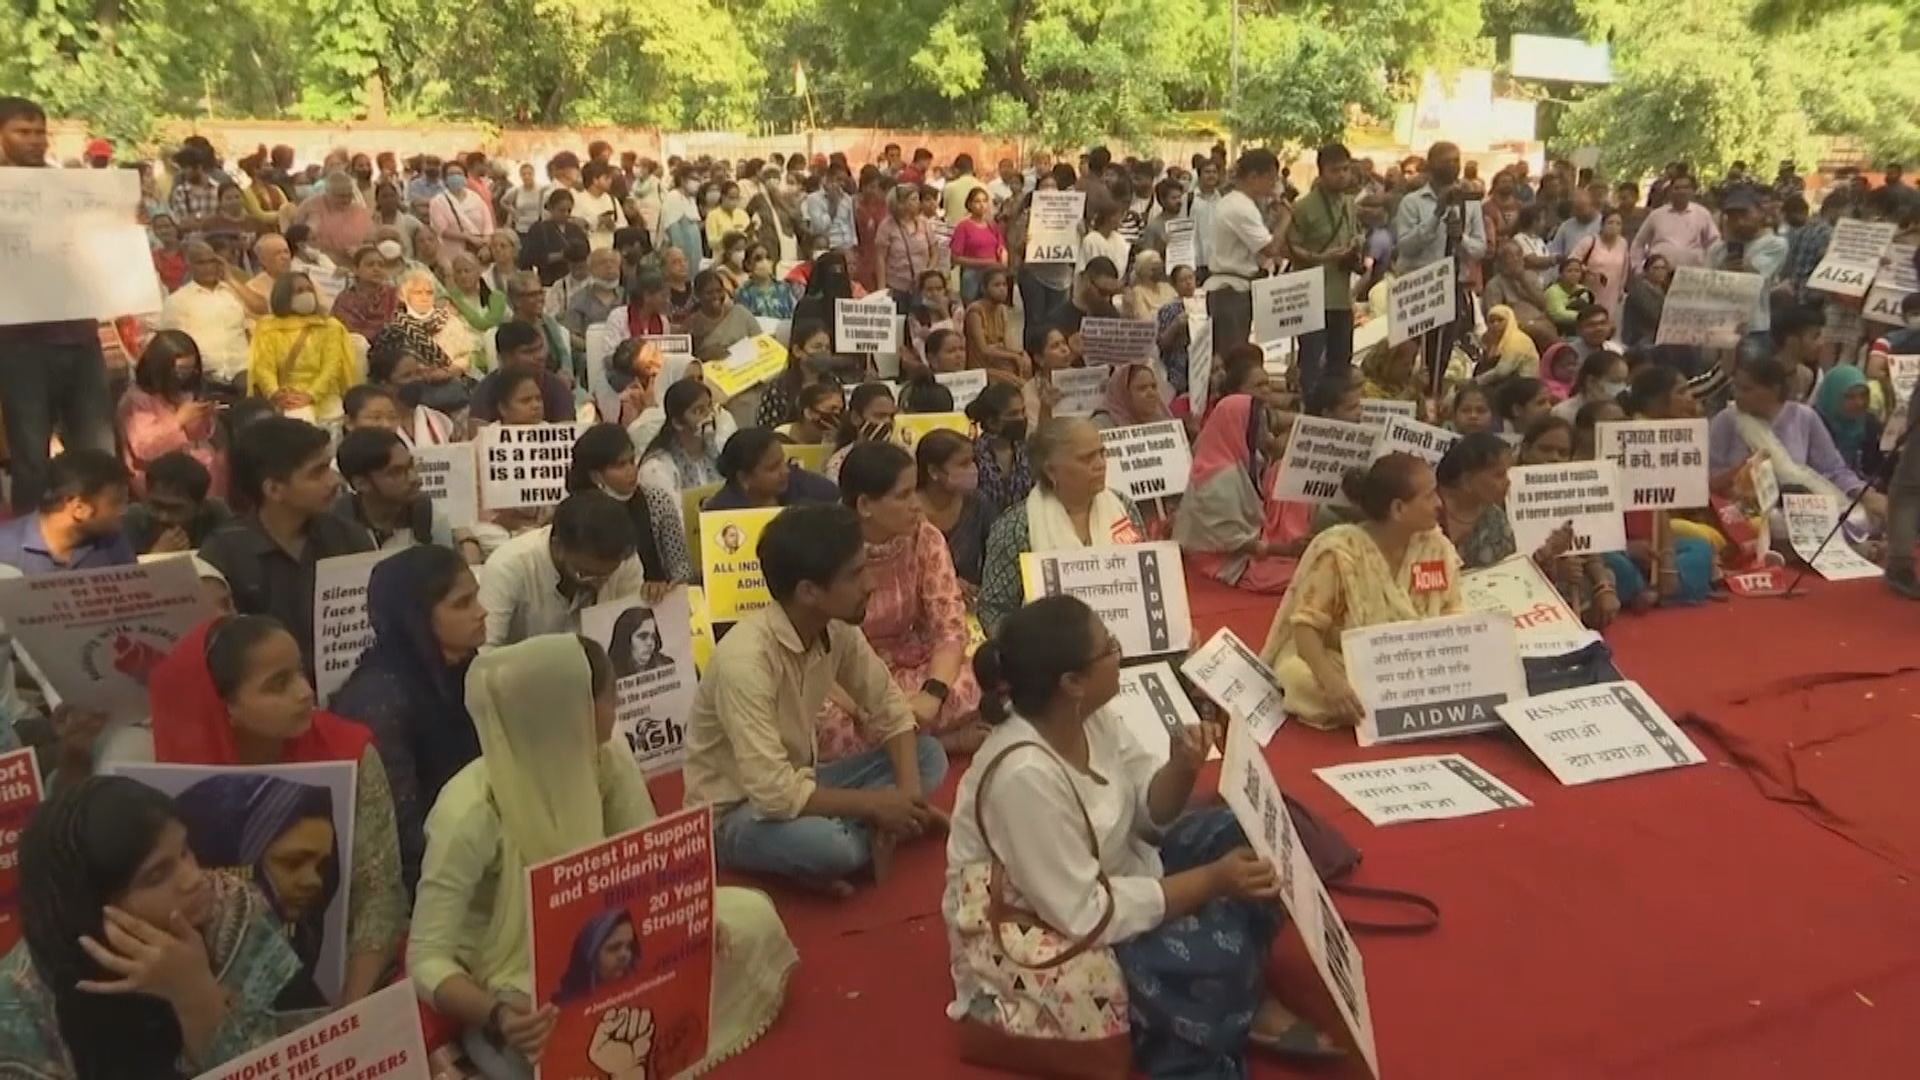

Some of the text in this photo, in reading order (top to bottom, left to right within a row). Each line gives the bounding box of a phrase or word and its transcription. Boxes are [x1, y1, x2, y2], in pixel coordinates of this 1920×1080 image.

[1034, 245, 1074, 259] AISA
[1817, 265, 1865, 286] AISA
[1872, 298, 1902, 315] AI
[500, 427, 576, 444] A rapist
[1617, 428, 1693, 450] गुजरात सरकार
[489, 445, 574, 462] is a rapi
[1605, 452, 1626, 469] र्म
[490, 465, 508, 481] is
[514, 467, 525, 480] a
[521, 488, 562, 502] NFIW
[1130, 477, 1166, 496] NFIW
[1302, 479, 1339, 498] NFIW
[1634, 487, 1675, 505] NFIW
[1568, 535, 1591, 551] IW
[713, 562, 734, 574] ALL
[1103, 553, 1127, 570] और
[1143, 554, 1166, 640] AIDWA
[323, 605, 356, 619] face
[322, 619, 368, 638] injust
[325, 658, 350, 672] the
[1147, 677, 1177, 726] AID
[1403, 703, 1486, 730] AIDWA
[553, 814, 706, 885] Protest in Support
[550, 836, 707, 909] and Solidarity with
[650, 876, 709, 913] 20 Year
[642, 898, 708, 936] Struggle
[688, 916, 709, 938] for
[286, 1014, 360, 1060] RELEASE
[287, 1053, 321, 1079] THE
